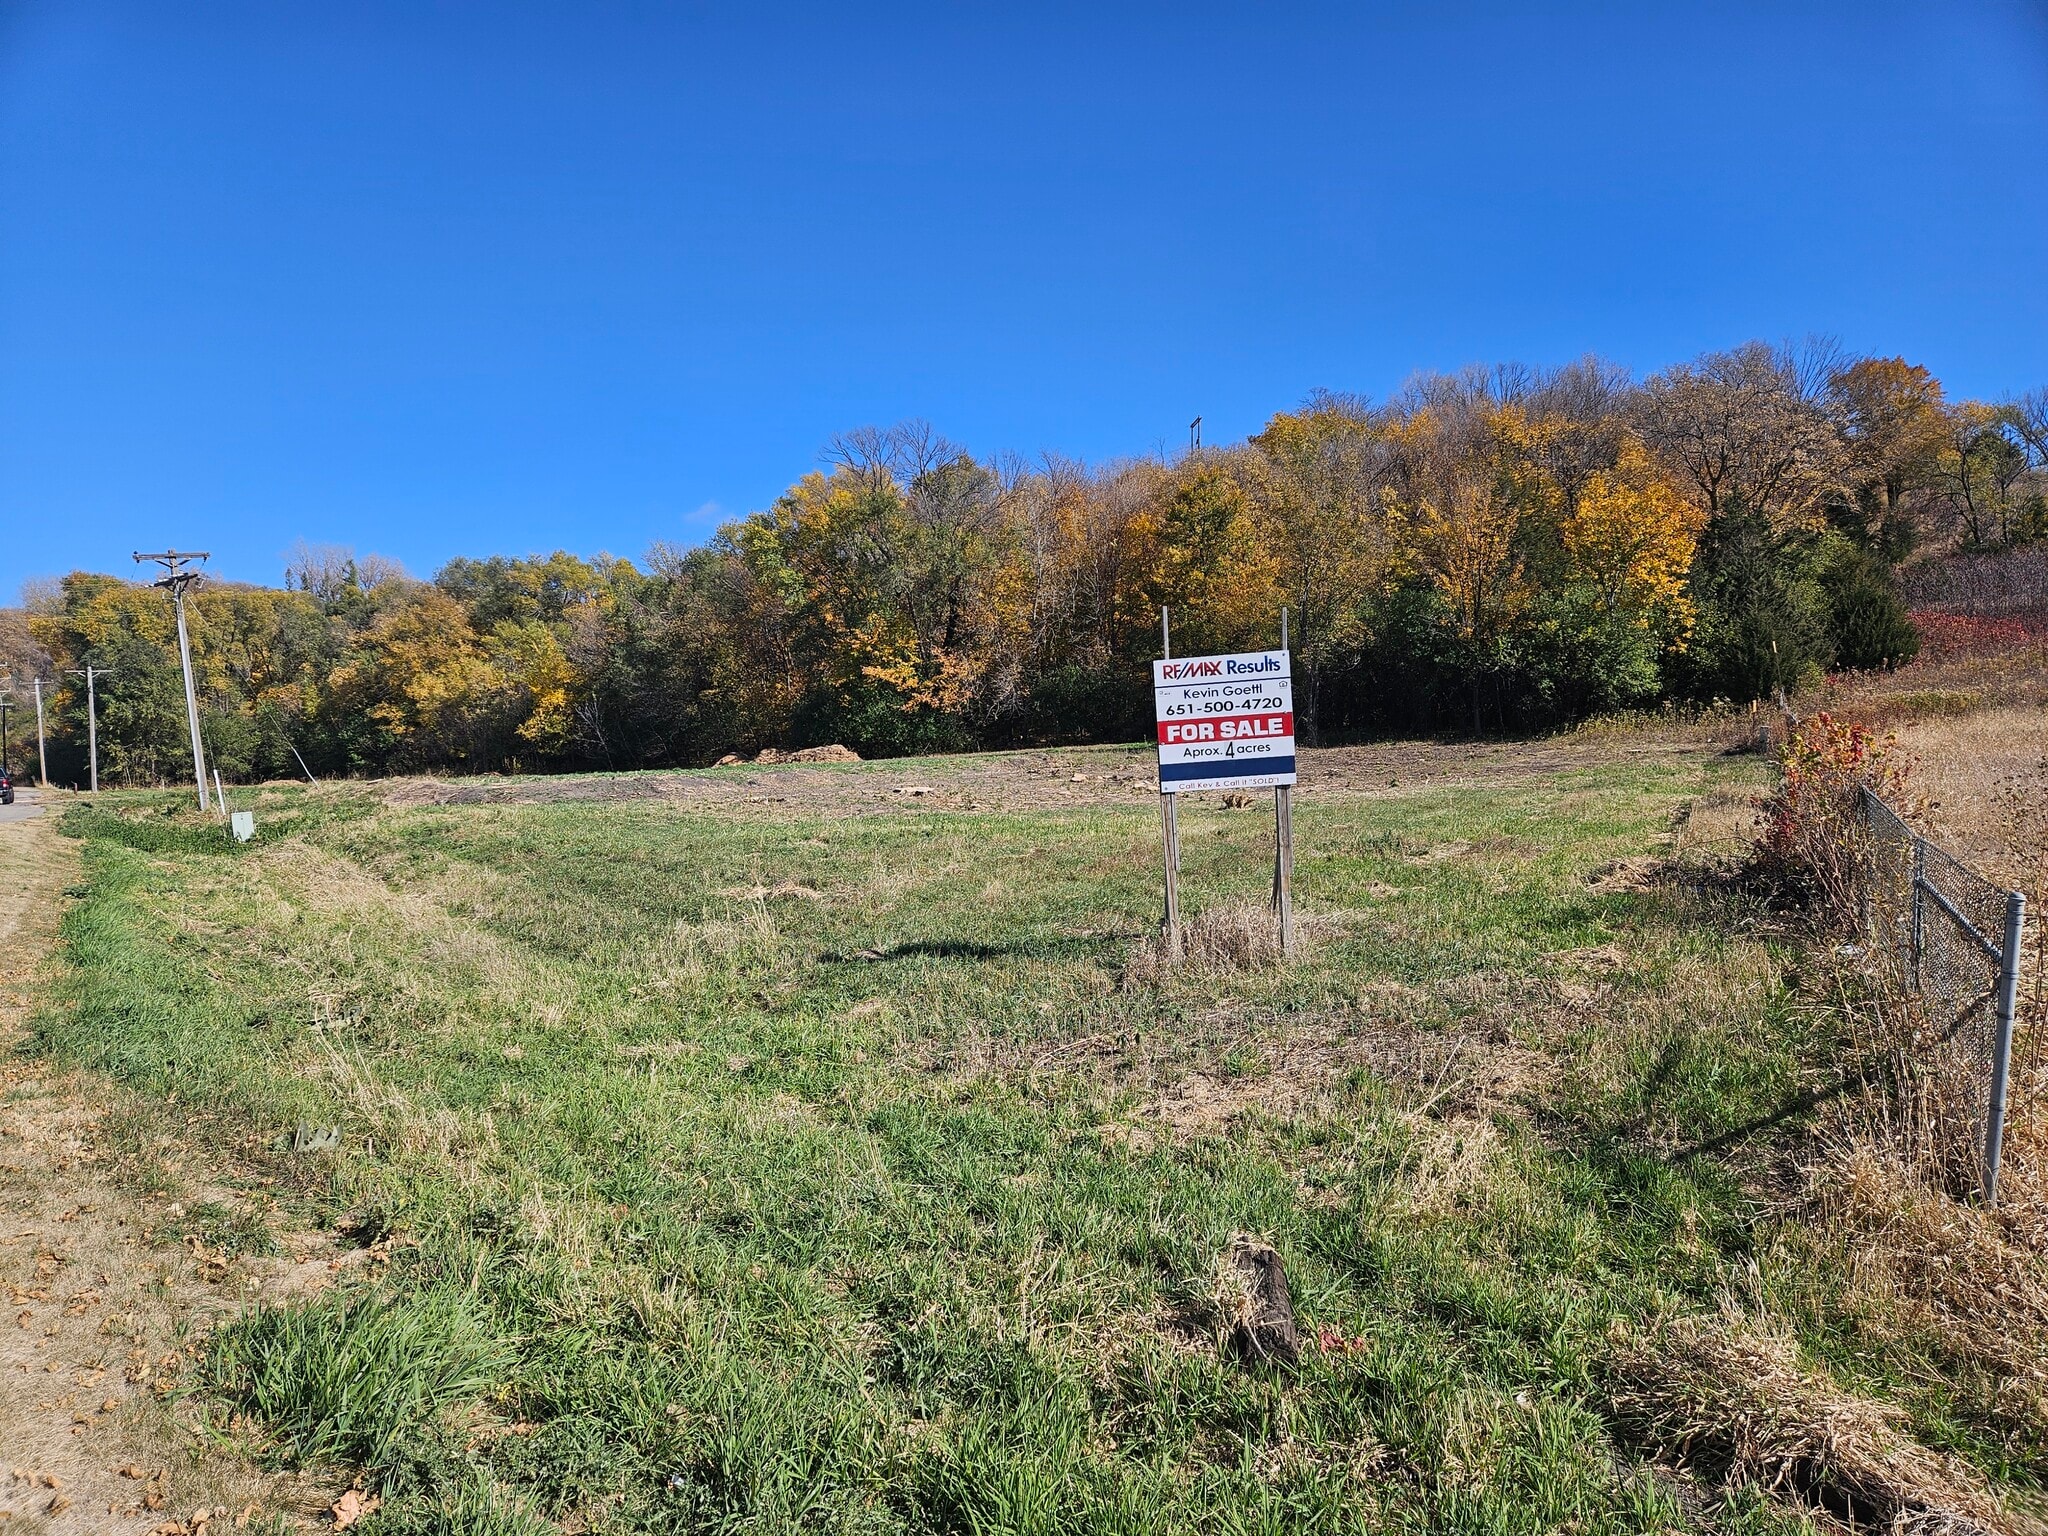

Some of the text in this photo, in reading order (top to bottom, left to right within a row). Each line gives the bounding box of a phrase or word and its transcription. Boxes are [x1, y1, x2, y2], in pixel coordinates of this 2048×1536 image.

[1163, 656, 1280, 680] RE/MAX Results
[1184, 688, 1218, 699] Kevin
[1223, 684, 1262, 696] Goettl
[1166, 697, 1282, 715] 651-500-4720
[1167, 718, 1283, 741] FOR SALE
[1184, 742, 1271, 758] Aprox. 4 acres
